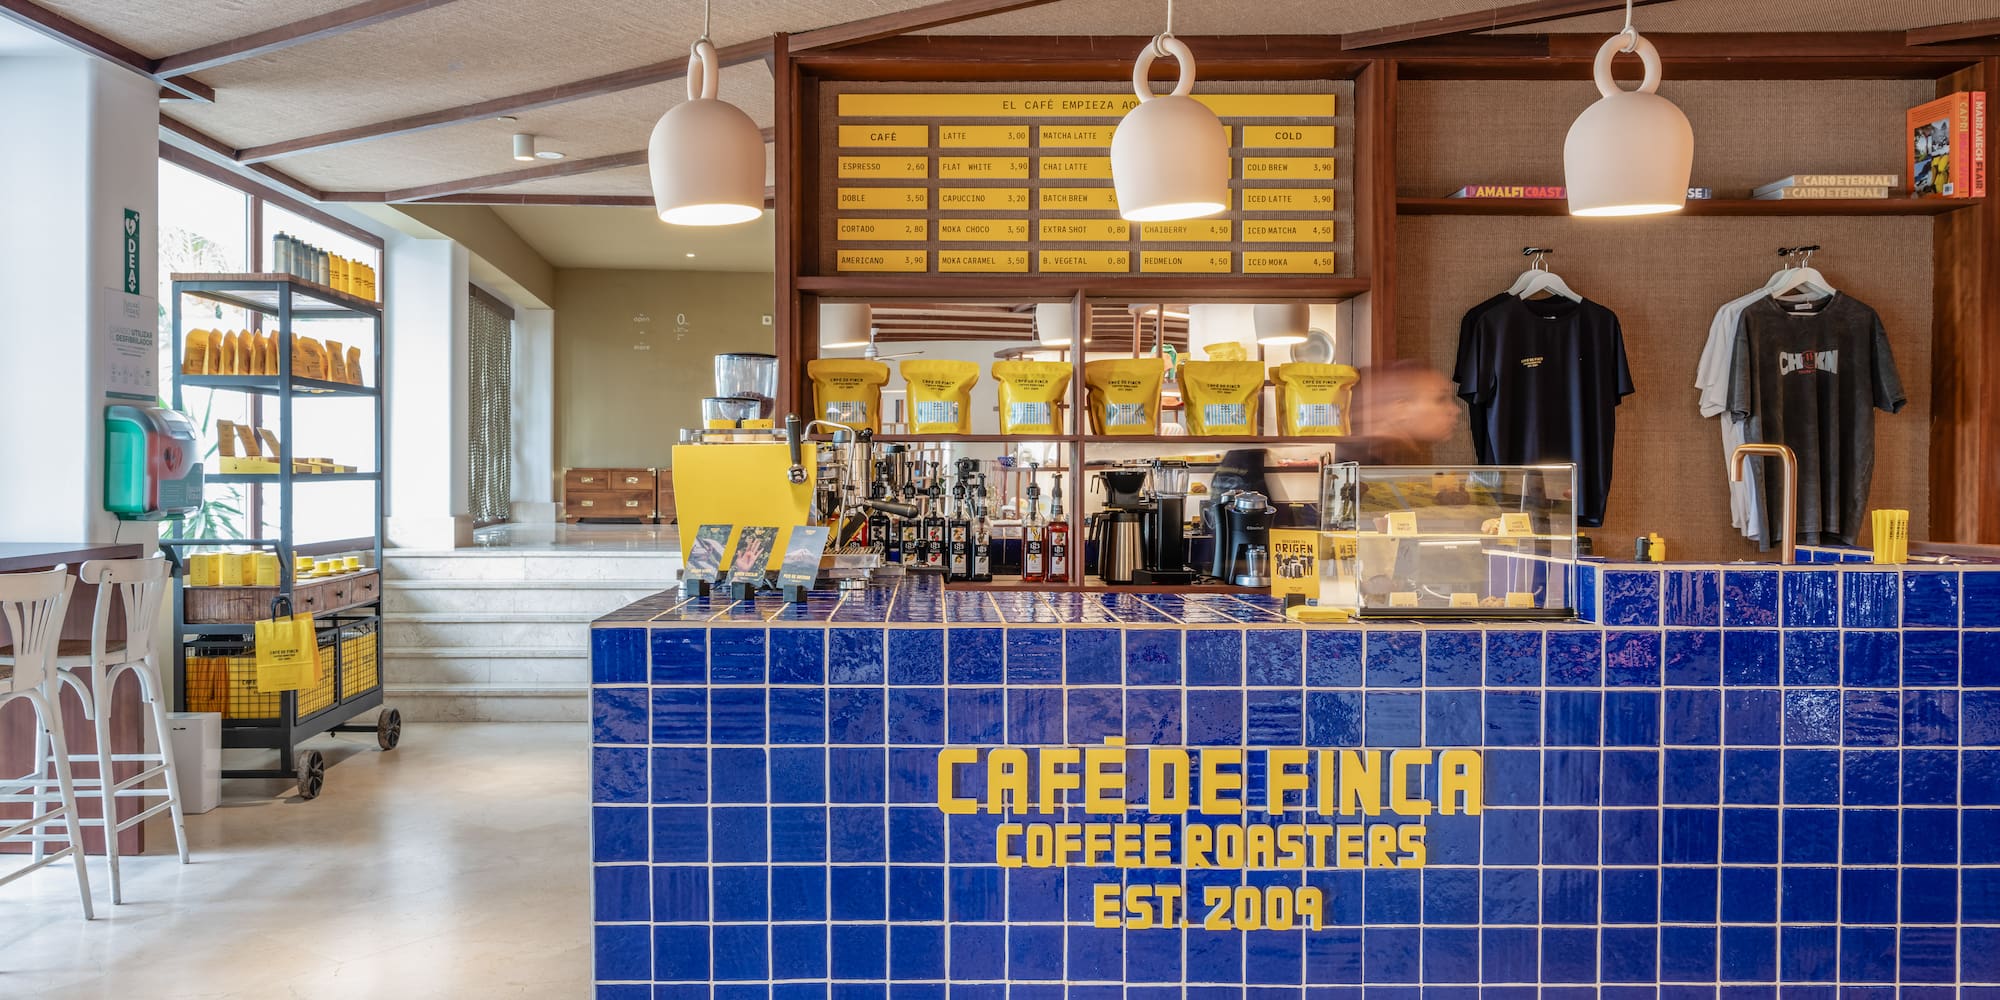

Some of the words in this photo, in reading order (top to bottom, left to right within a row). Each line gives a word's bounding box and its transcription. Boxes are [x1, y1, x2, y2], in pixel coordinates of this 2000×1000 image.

[1003, 101, 1016, 109] EL
[1025, 99, 1053, 109] CAFÉ
[1062, 101, 1113, 109] EMPIEZA
[1959, 101, 1969, 132] CAPRI
[871, 133, 896, 141] CAFÉ
[1008, 132, 1025, 140] 3,00
[1275, 132, 1302, 140] COLD
[1975, 101, 1984, 161] MARRAKECH
[1010, 163, 1027, 171] 3,90
[1803, 175, 1838, 187] CAIRO
[1839, 175, 1890, 187] ETERNAL
[1975, 161, 1984, 189] FLAIR
[1475, 185, 1524, 198] AMALFI
[1525, 186, 1562, 198] COAST
[1792, 187, 1826, 199] CAIRO
[1827, 187, 1879, 199] ETERNAL
[907, 195, 924, 203] 3,50
[128, 238, 136, 284] DEA
[1210, 258, 1227, 266] 4,50
[1275, 543, 1314, 553] ORIGEN
[938, 735, 1126, 815] CAFÉ
[1148, 748, 1242, 815] DE
[1266, 748, 1482, 816] FINCA
[997, 823, 1172, 868] COFFEE
[1185, 824, 1427, 869] ROASTERS
[1094, 884, 1188, 929] EST.
[1204, 885, 1323, 931] 2009
